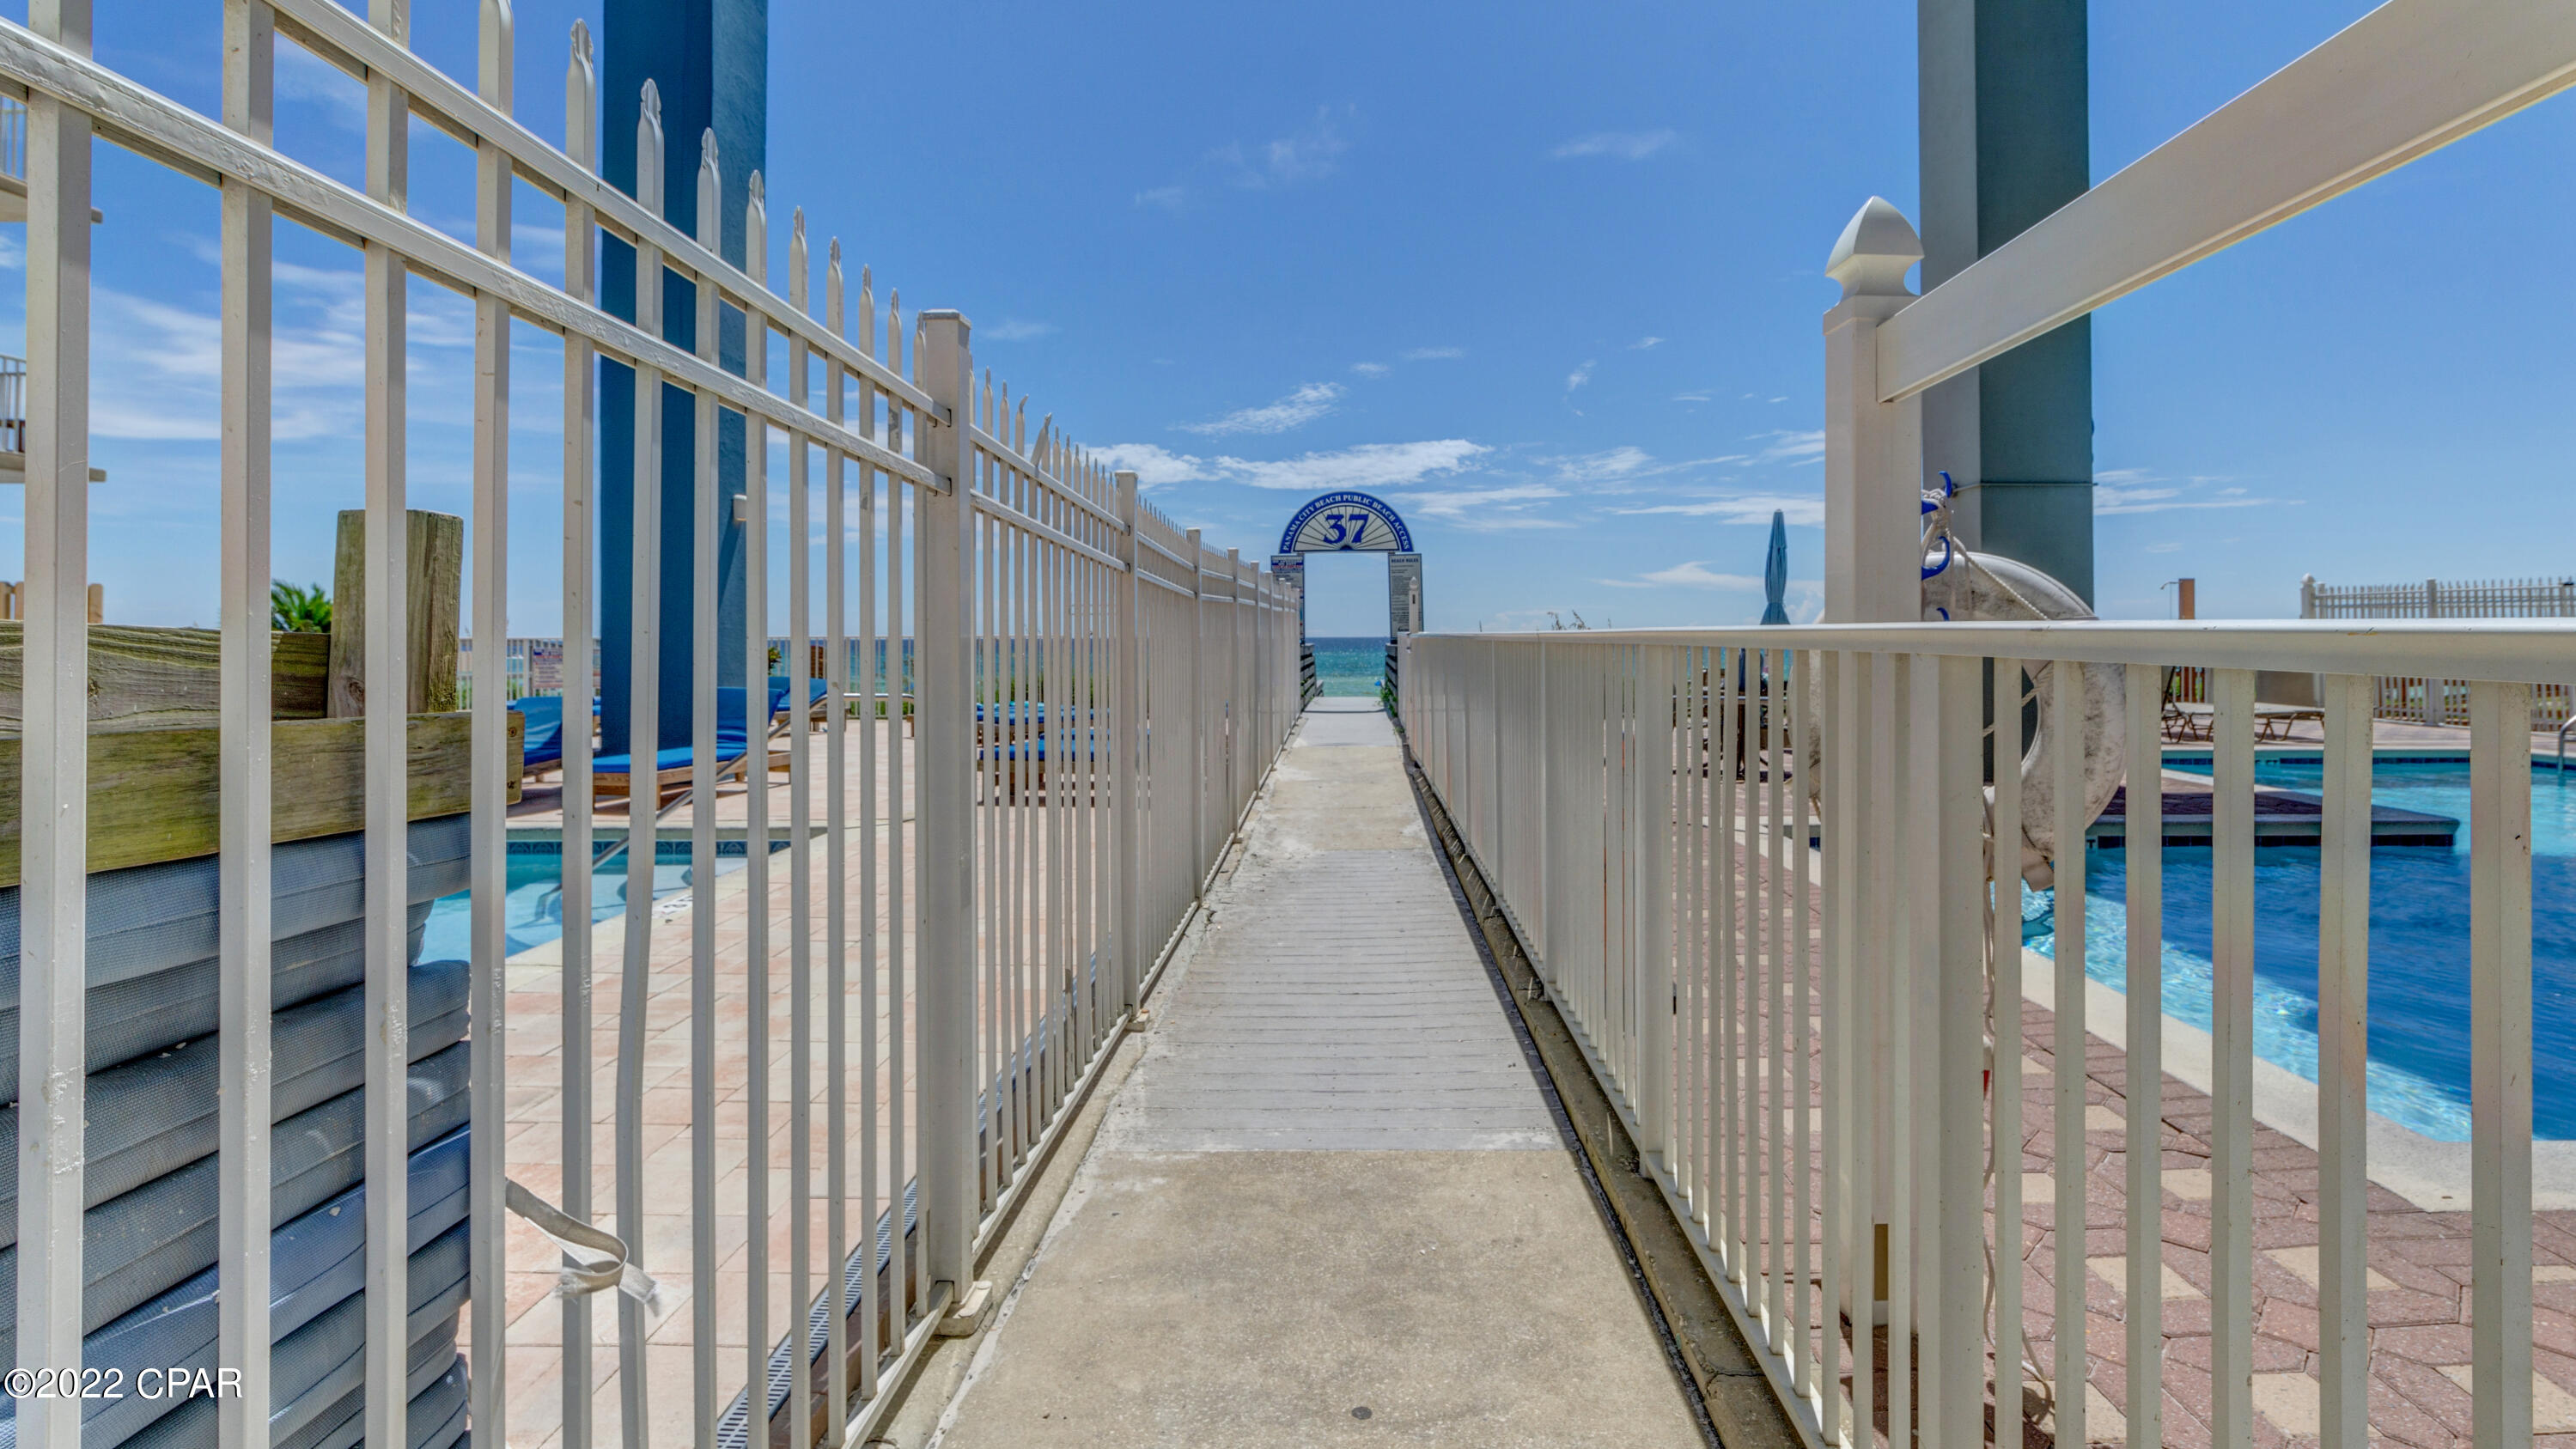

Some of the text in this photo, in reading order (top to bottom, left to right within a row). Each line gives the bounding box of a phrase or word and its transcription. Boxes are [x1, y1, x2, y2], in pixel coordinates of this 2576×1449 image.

[1283, 494, 1410, 551] PANAMA CITY BEACH PUBLIC BEACH ACCESS
[1324, 514, 1370, 544] 37
